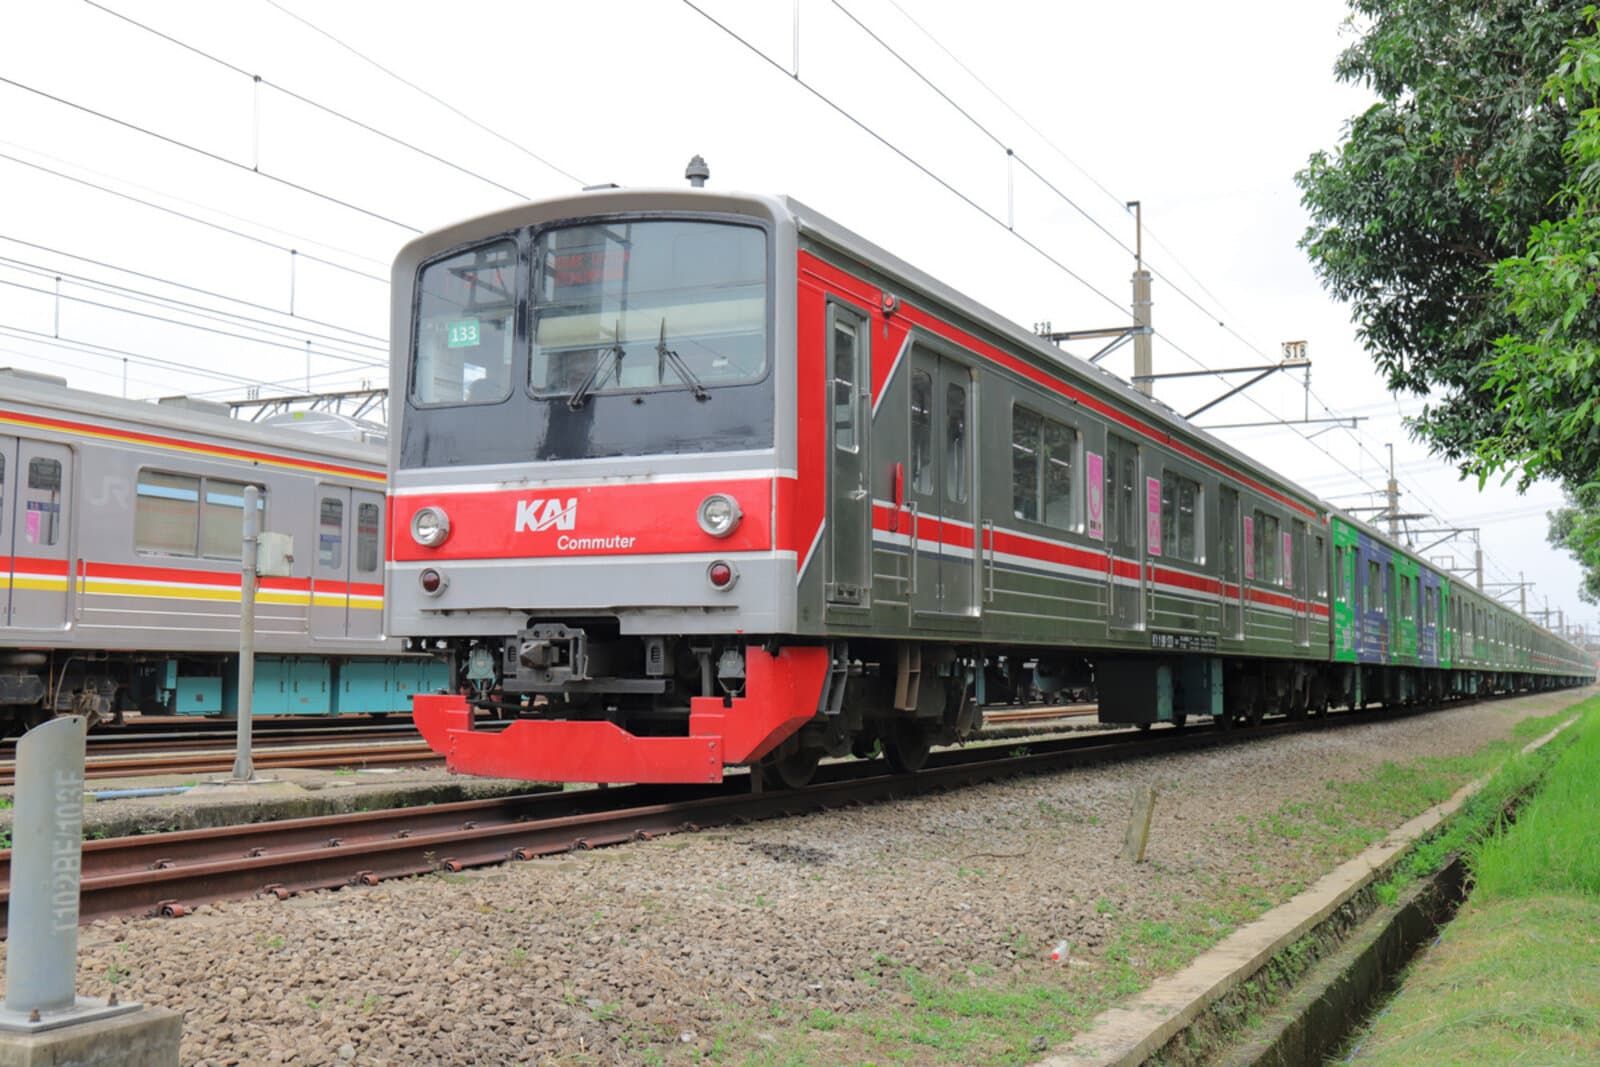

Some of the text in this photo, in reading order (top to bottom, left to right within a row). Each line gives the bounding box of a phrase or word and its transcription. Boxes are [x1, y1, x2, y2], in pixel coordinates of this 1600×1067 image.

[451, 326, 477, 342] 133
[514, 497, 578, 532] KAI
[557, 535, 635, 550] Commuter
